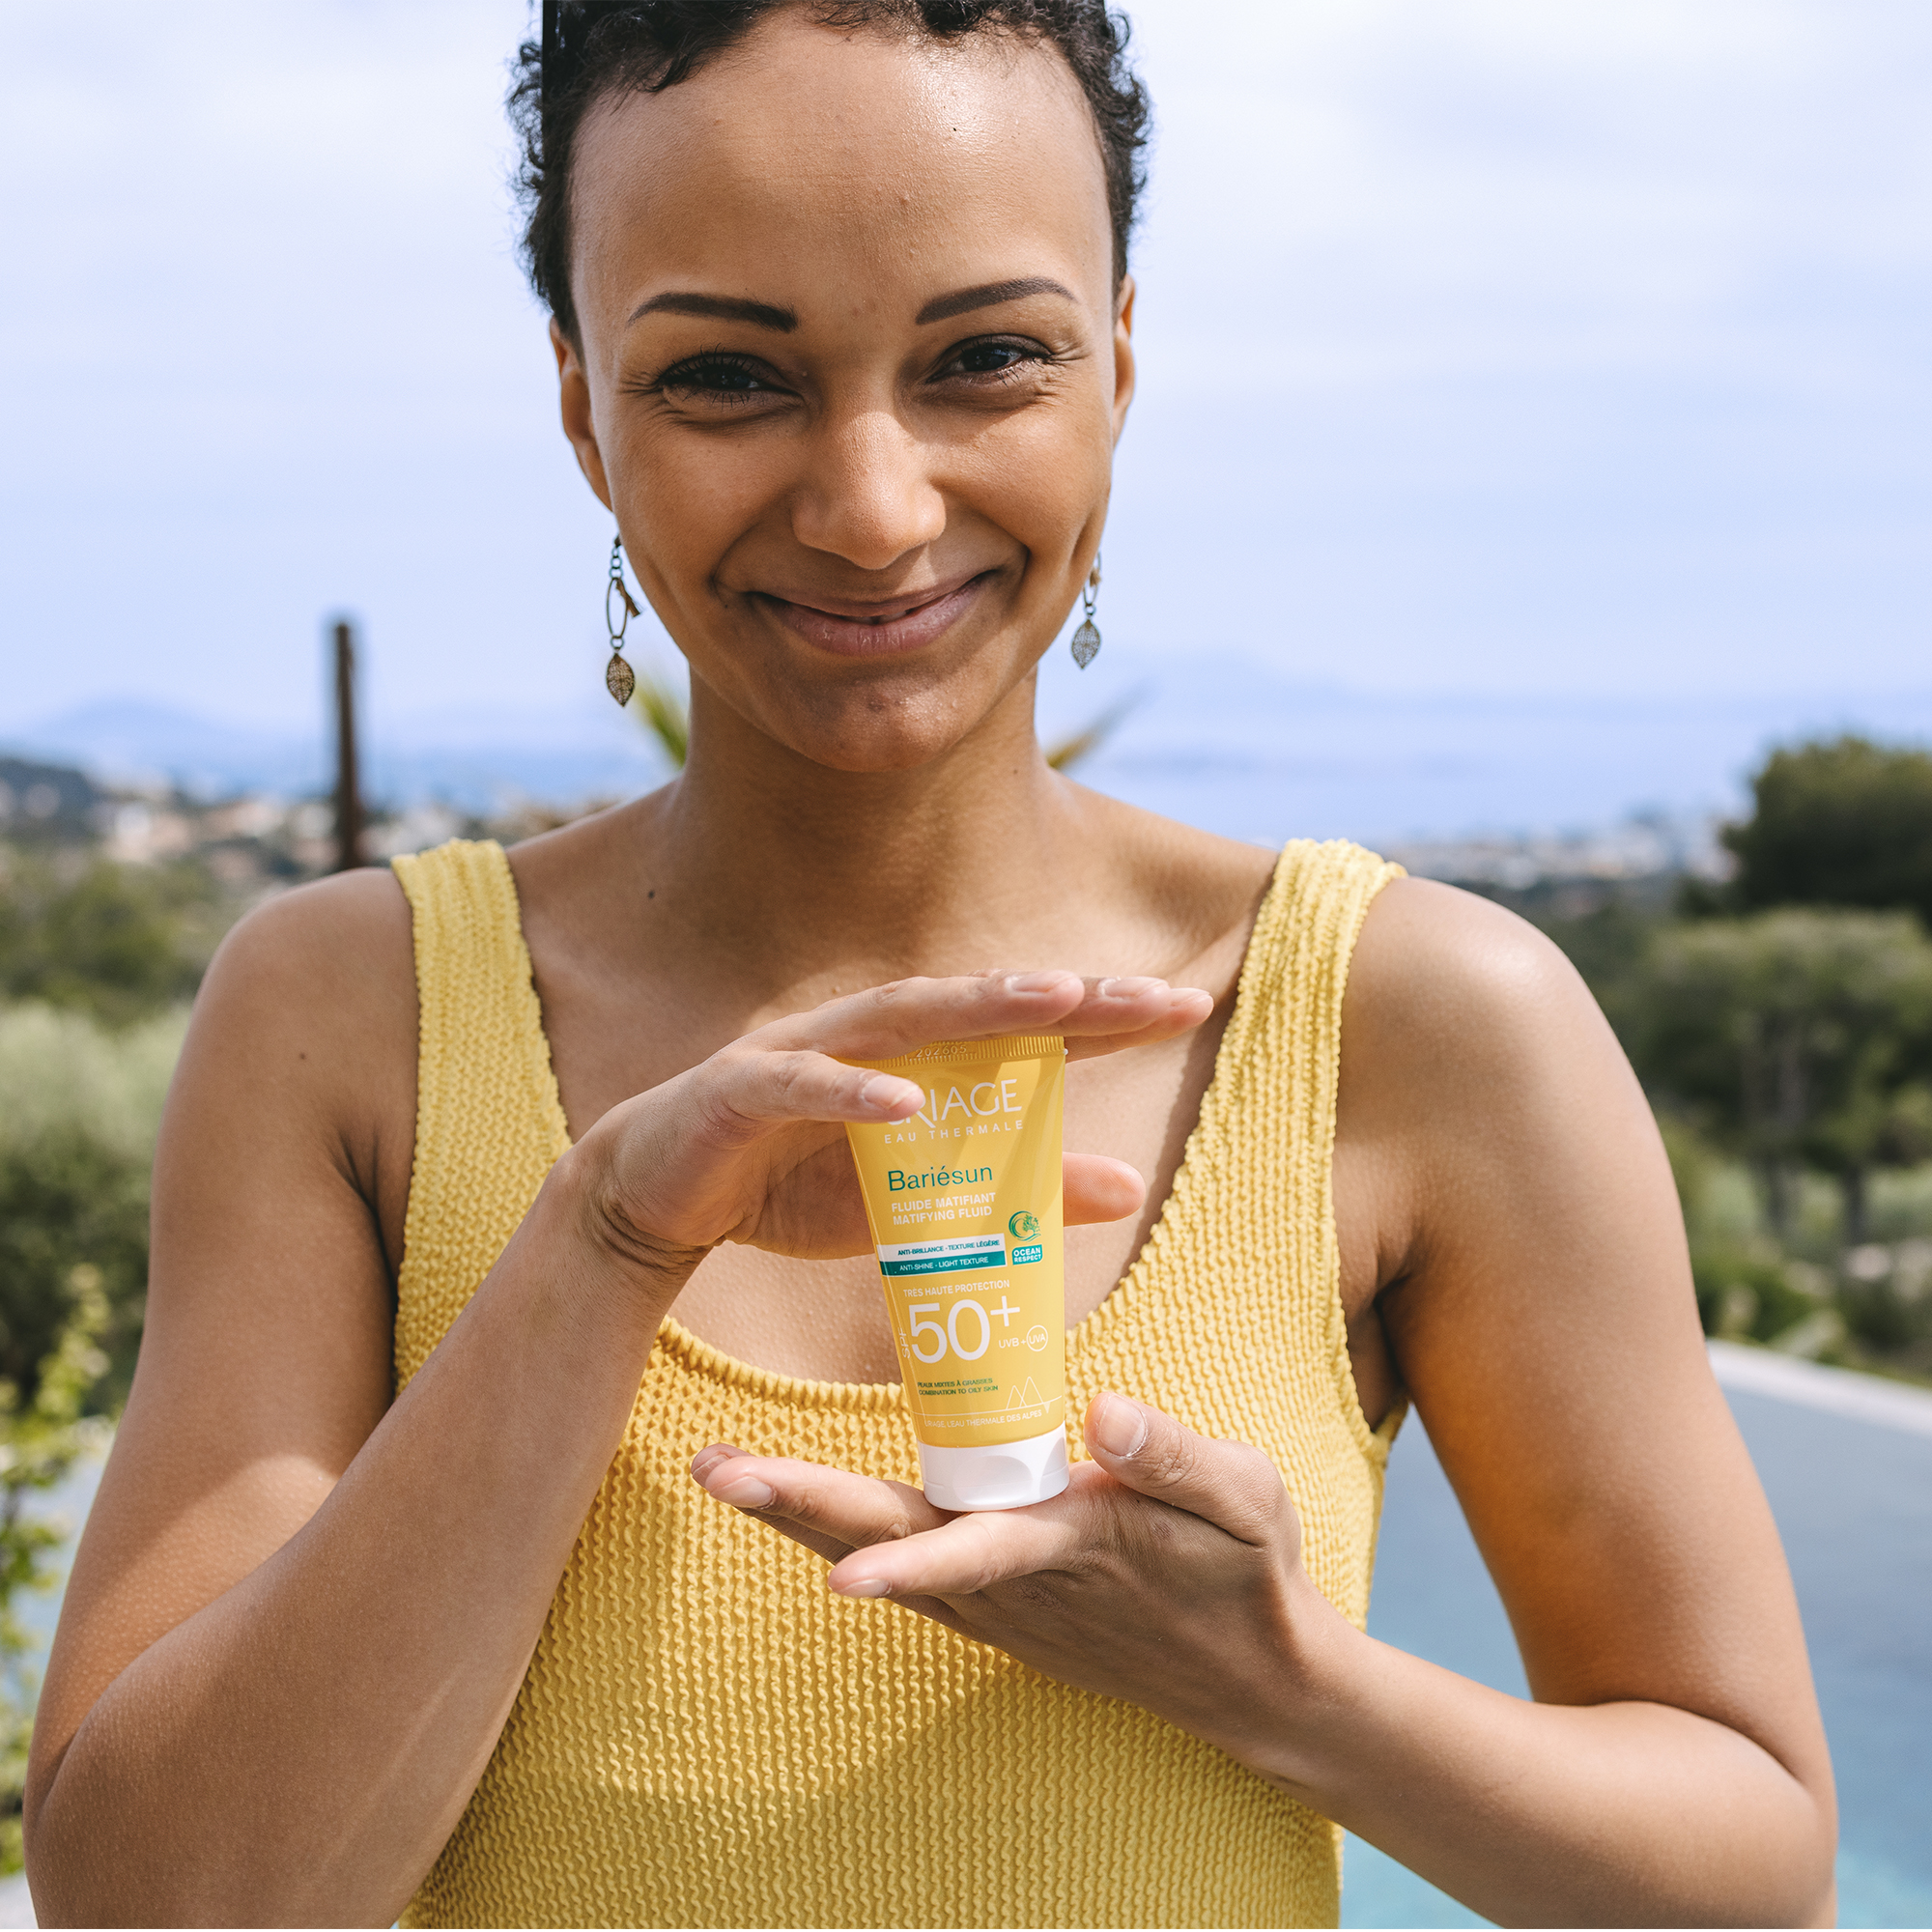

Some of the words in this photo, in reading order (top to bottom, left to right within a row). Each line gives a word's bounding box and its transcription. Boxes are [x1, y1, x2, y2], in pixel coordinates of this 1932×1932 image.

[886, 1079, 1022, 1128] RIAGE
[885, 1133, 916, 1144] EAU
[929, 1120, 1023, 1140] THERMALE
[889, 1165, 993, 1191] Bariésun
[892, 1199, 932, 1212] FLUIDE
[936, 1192, 996, 1208] MATIFIANT
[894, 1209, 955, 1225] MATIFYING
[959, 1206, 992, 1218] FLUID
[897, 1246, 944, 1256] ANTI-BRILLANCE
[949, 1242, 975, 1251] TEXTURE
[977, 1239, 1000, 1248] LÉGÈRE
[1013, 1247, 1040, 1257] OCEAN
[899, 1263, 934, 1271] ANTI-SHINE
[939, 1260, 958, 1268] LIGHT
[959, 1257, 988, 1265] TEXTURE
[903, 1288, 923, 1297] TRÈS
[925, 1285, 953, 1295] HAUTE
[955, 1280, 1009, 1293] PROTECTION
[998, 1338, 1019, 1349] UVB
[1029, 1334, 1045, 1345] UVA
[966, 1415, 1005, 1427] THERMALE
[1007, 1413, 1021, 1422] DES
[1022, 1409, 1041, 1421] ALPES
